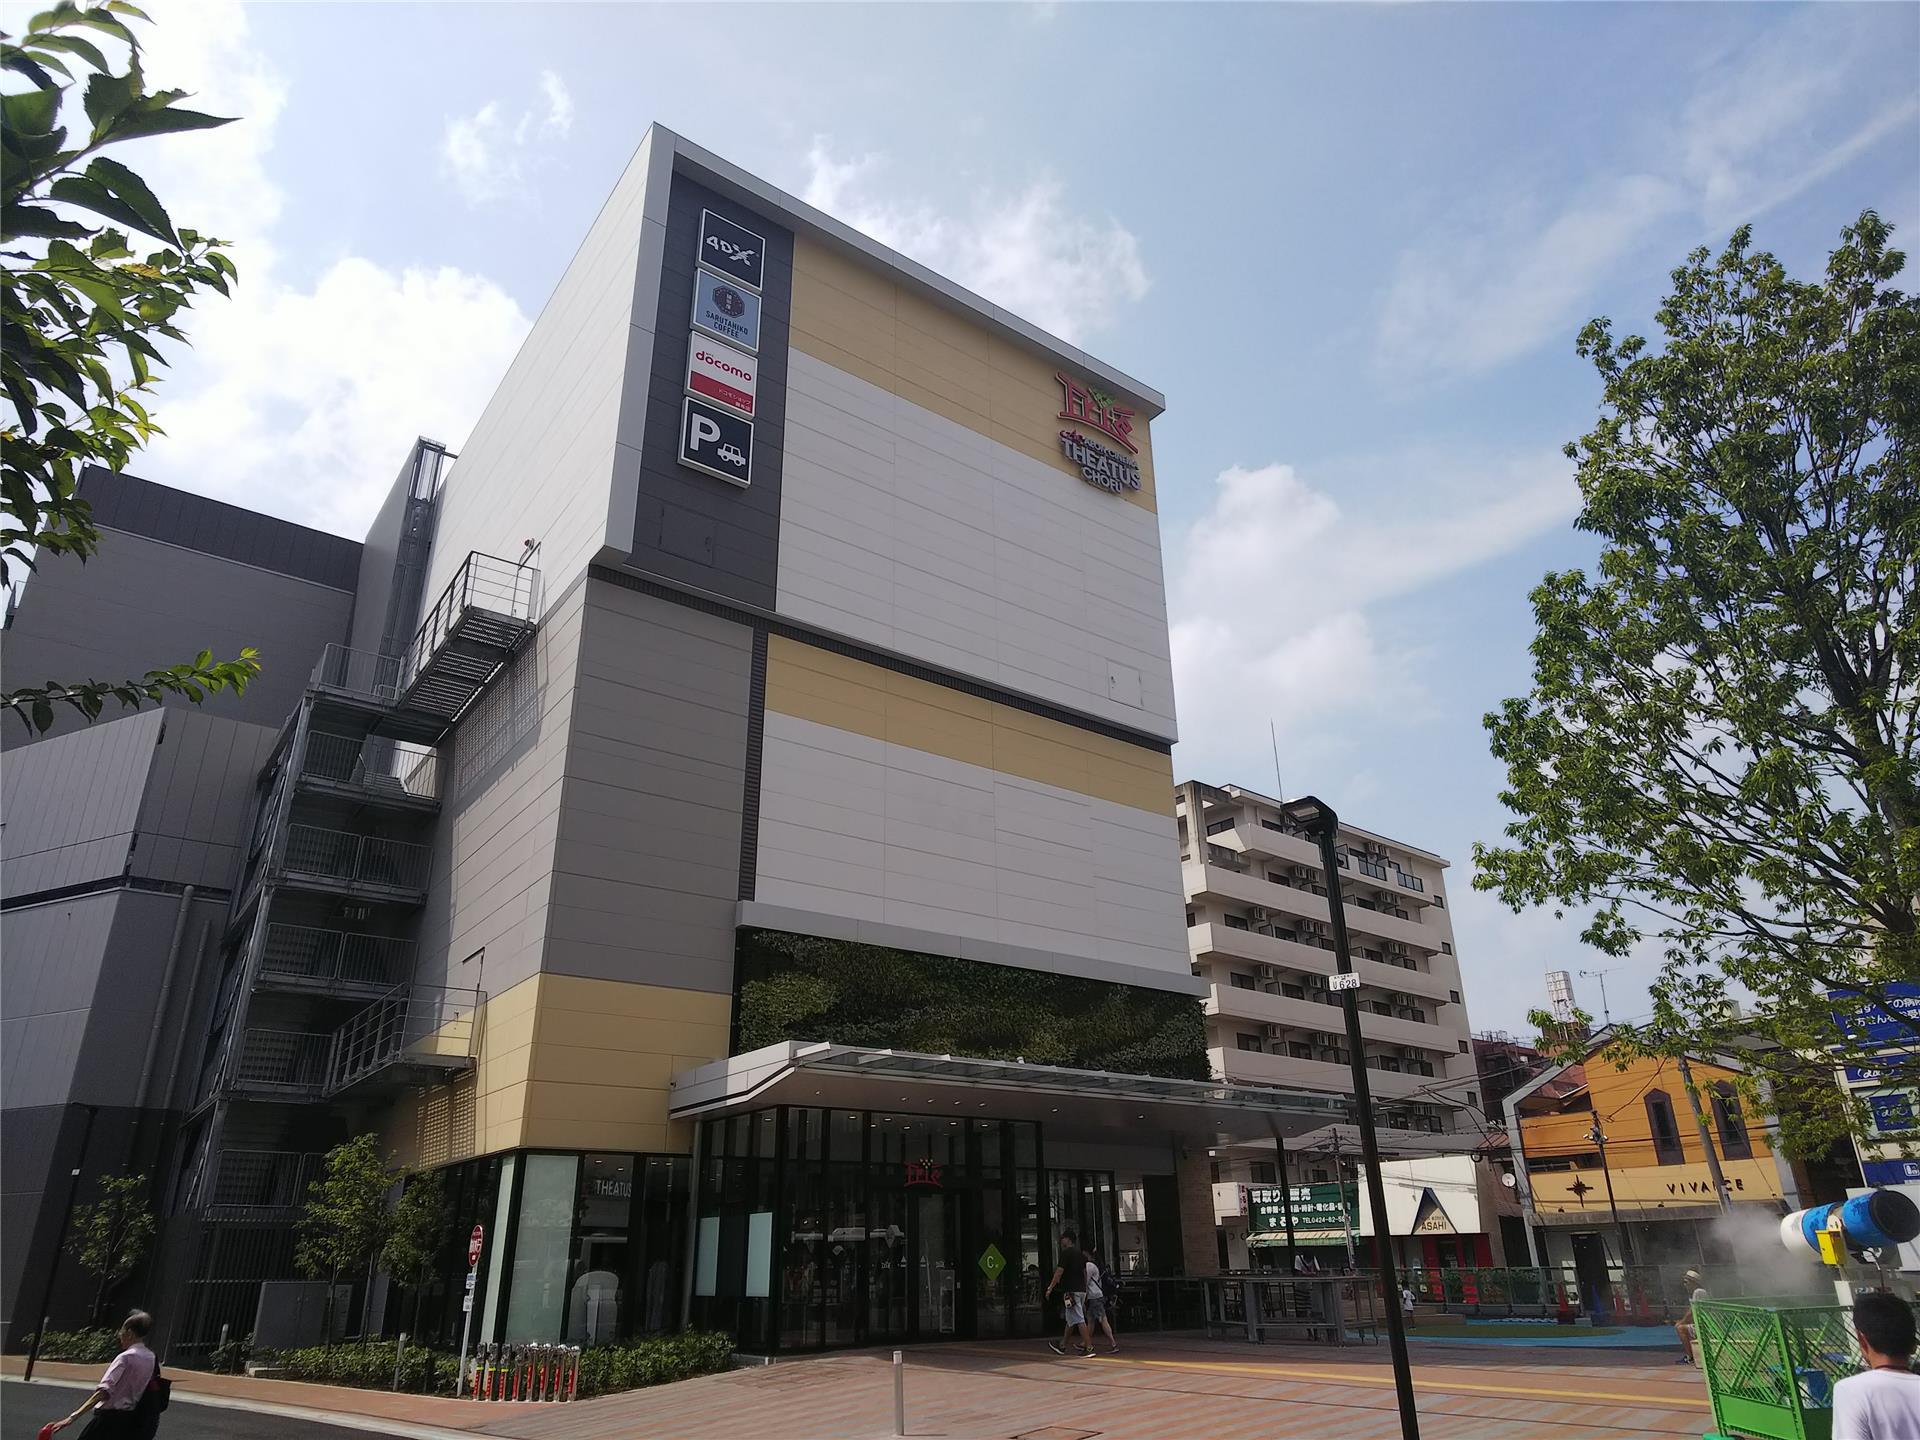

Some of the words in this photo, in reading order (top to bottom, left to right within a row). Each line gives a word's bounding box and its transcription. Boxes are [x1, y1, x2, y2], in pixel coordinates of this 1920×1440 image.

[705, 310, 749, 335] SARUTAHIKO
[713, 321, 740, 338] COFFEE
[695, 350, 752, 381] docomo
[689, 412, 721, 451] P
[1061, 437, 1142, 490] THEATUS
[1082, 466, 1123, 494] CHOFU
[596, 1180, 632, 1198] THEATUS
[1666, 1178, 1745, 1195] VIVACE
[1421, 1221, 1447, 1231] ASAHI
